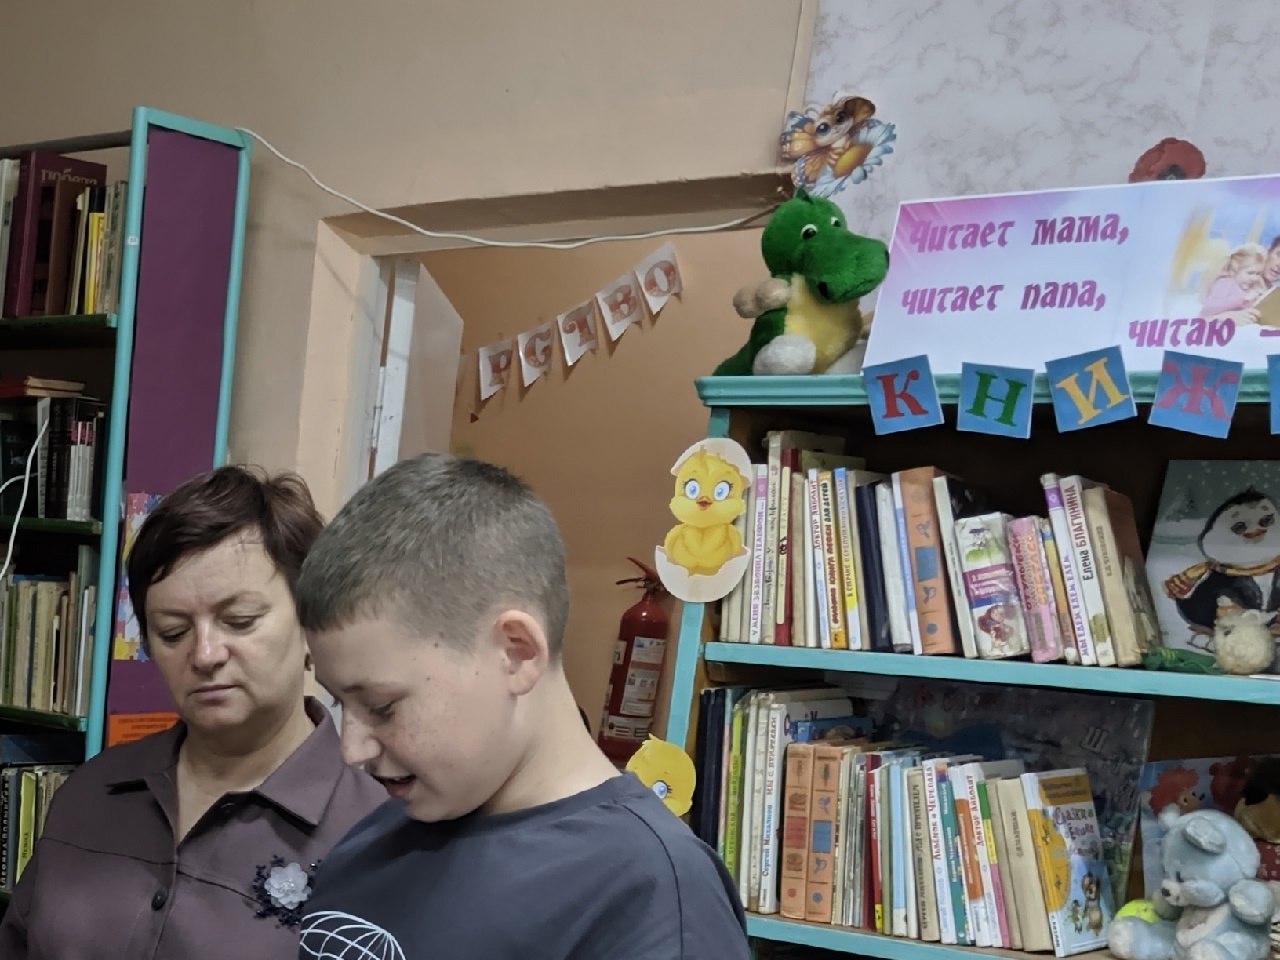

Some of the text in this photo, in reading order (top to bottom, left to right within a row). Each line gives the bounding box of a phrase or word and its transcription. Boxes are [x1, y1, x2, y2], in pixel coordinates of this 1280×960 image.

[909, 212, 1130, 254] Читает мама,
[901, 277, 1107, 316] читает папа,
[1129, 316, 1236, 348] читаю
[810, 478, 822, 550] ДОКТОР АЙБОЛИТ
[820, 482, 830, 507] ДЕТЕЙ
[823, 508, 832, 523] ДЛЯ
[1064, 485, 1093, 580] Елена БЛАГИНИНА
[1080, 639, 1089, 656] МЫ
[925, 766, 938, 811] ЧЕРЕПАХА
[764, 804, 773, 845] Михалков
[966, 775, 984, 846] ДОКТОР АЙБОЛИТ
[762, 848, 771, 877] Сергей
